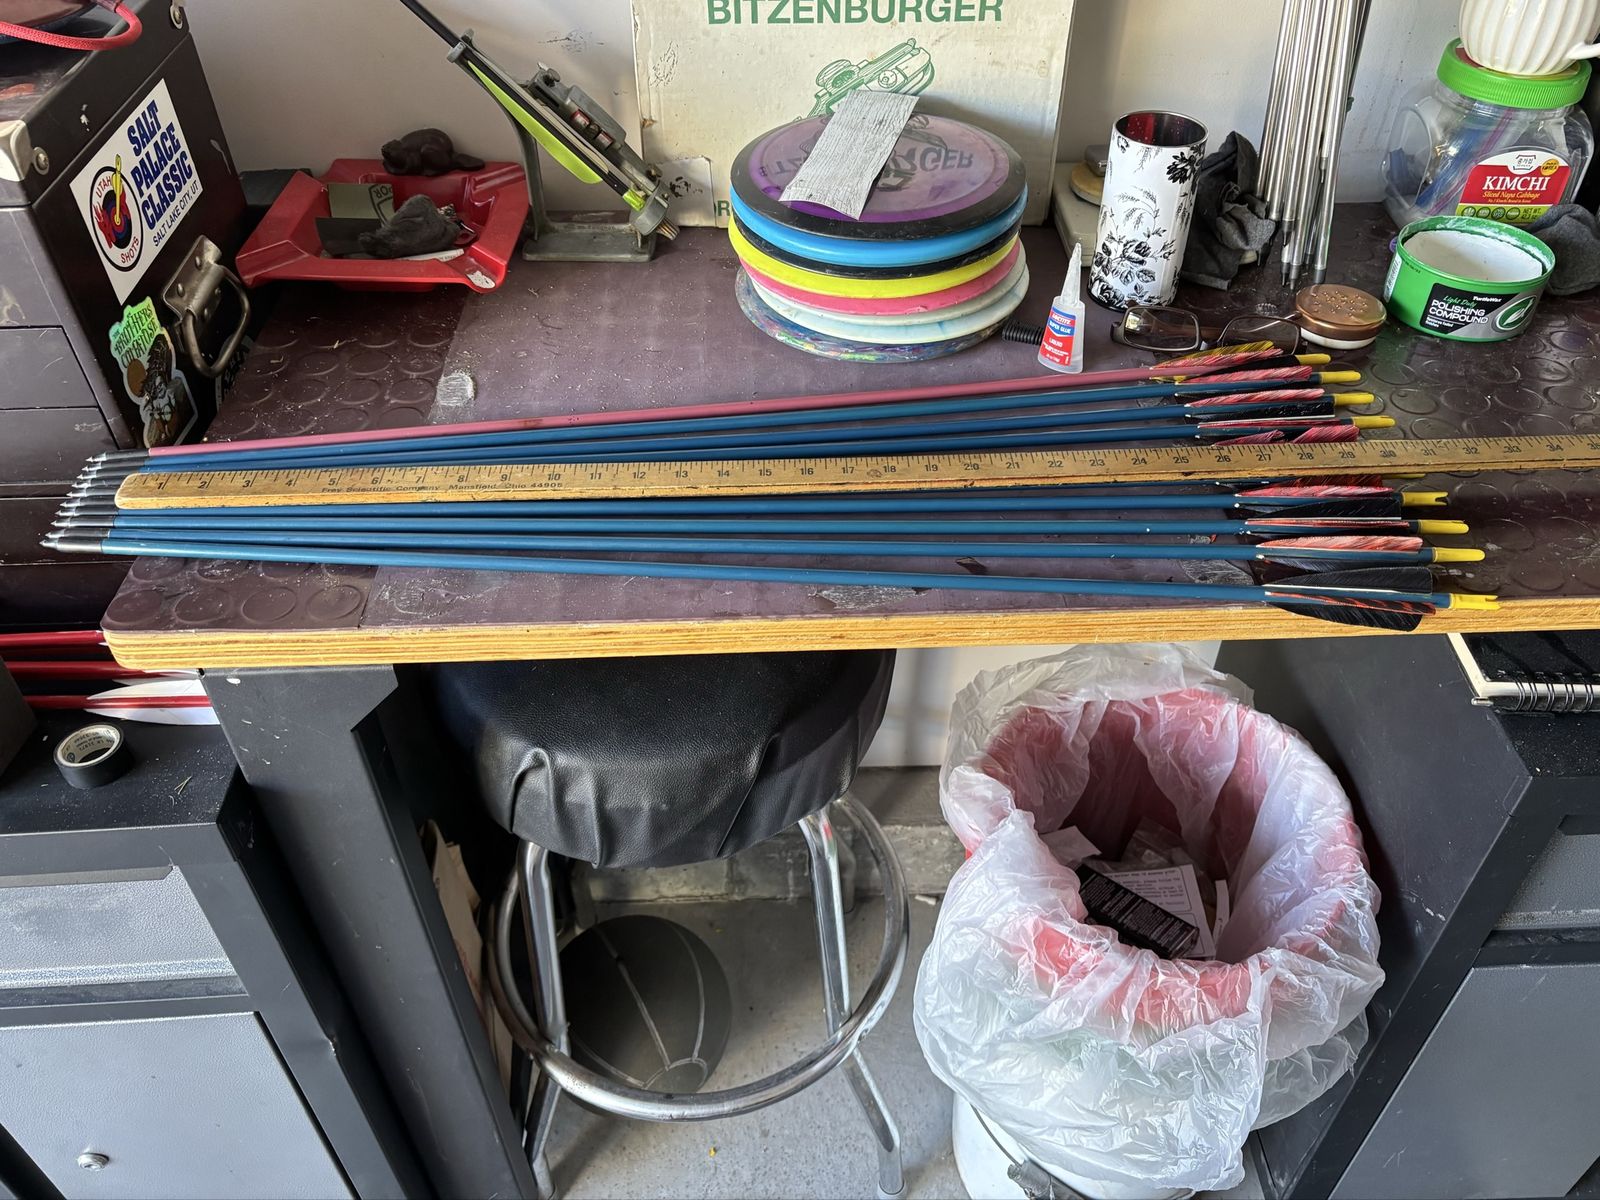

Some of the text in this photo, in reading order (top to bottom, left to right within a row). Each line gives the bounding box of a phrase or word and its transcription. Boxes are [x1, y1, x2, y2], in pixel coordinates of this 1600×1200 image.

[708, 0, 1002, 25] BITZENBURGER
[127, 99, 162, 156] SALT
[131, 122, 181, 198] PALACE
[96, 176, 112, 198] UTAH
[141, 151, 193, 230] CLASSIC
[1482, 176, 1551, 191] KIMCHI
[153, 180, 200, 247] SALT LAKE CITY, UT
[121, 236, 139, 264] SHOTS
[1431, 299, 1486, 317] POLISHING
[1443, 295, 1477, 308] Light Duty
[1429, 307, 1489, 324] COMPOUND
[547, 473, 561, 481] 10
[590, 472, 602, 480] 11
[632, 471, 646, 479] 12
[675, 470, 688, 478] 13
[718, 469, 730, 477] 14
[801, 467, 814, 475] 16
[842, 466, 854, 474] 17
[884, 465, 896, 473] 18
[925, 464, 938, 472] 19
[1006, 461, 1020, 469] 21
[1048, 460, 1062, 468] 22
[1090, 459, 1105, 467] 23
[1173, 456, 1189, 464] 25
[1256, 453, 1272, 461] 27
[1297, 452, 1314, 460] 28
[1339, 451, 1355, 459] 29
[1462, 447, 1480, 455] 32
[1504, 445, 1521, 453] 33
[1546, 443, 1563, 451] 34
[396, 485, 440, 493] Company
